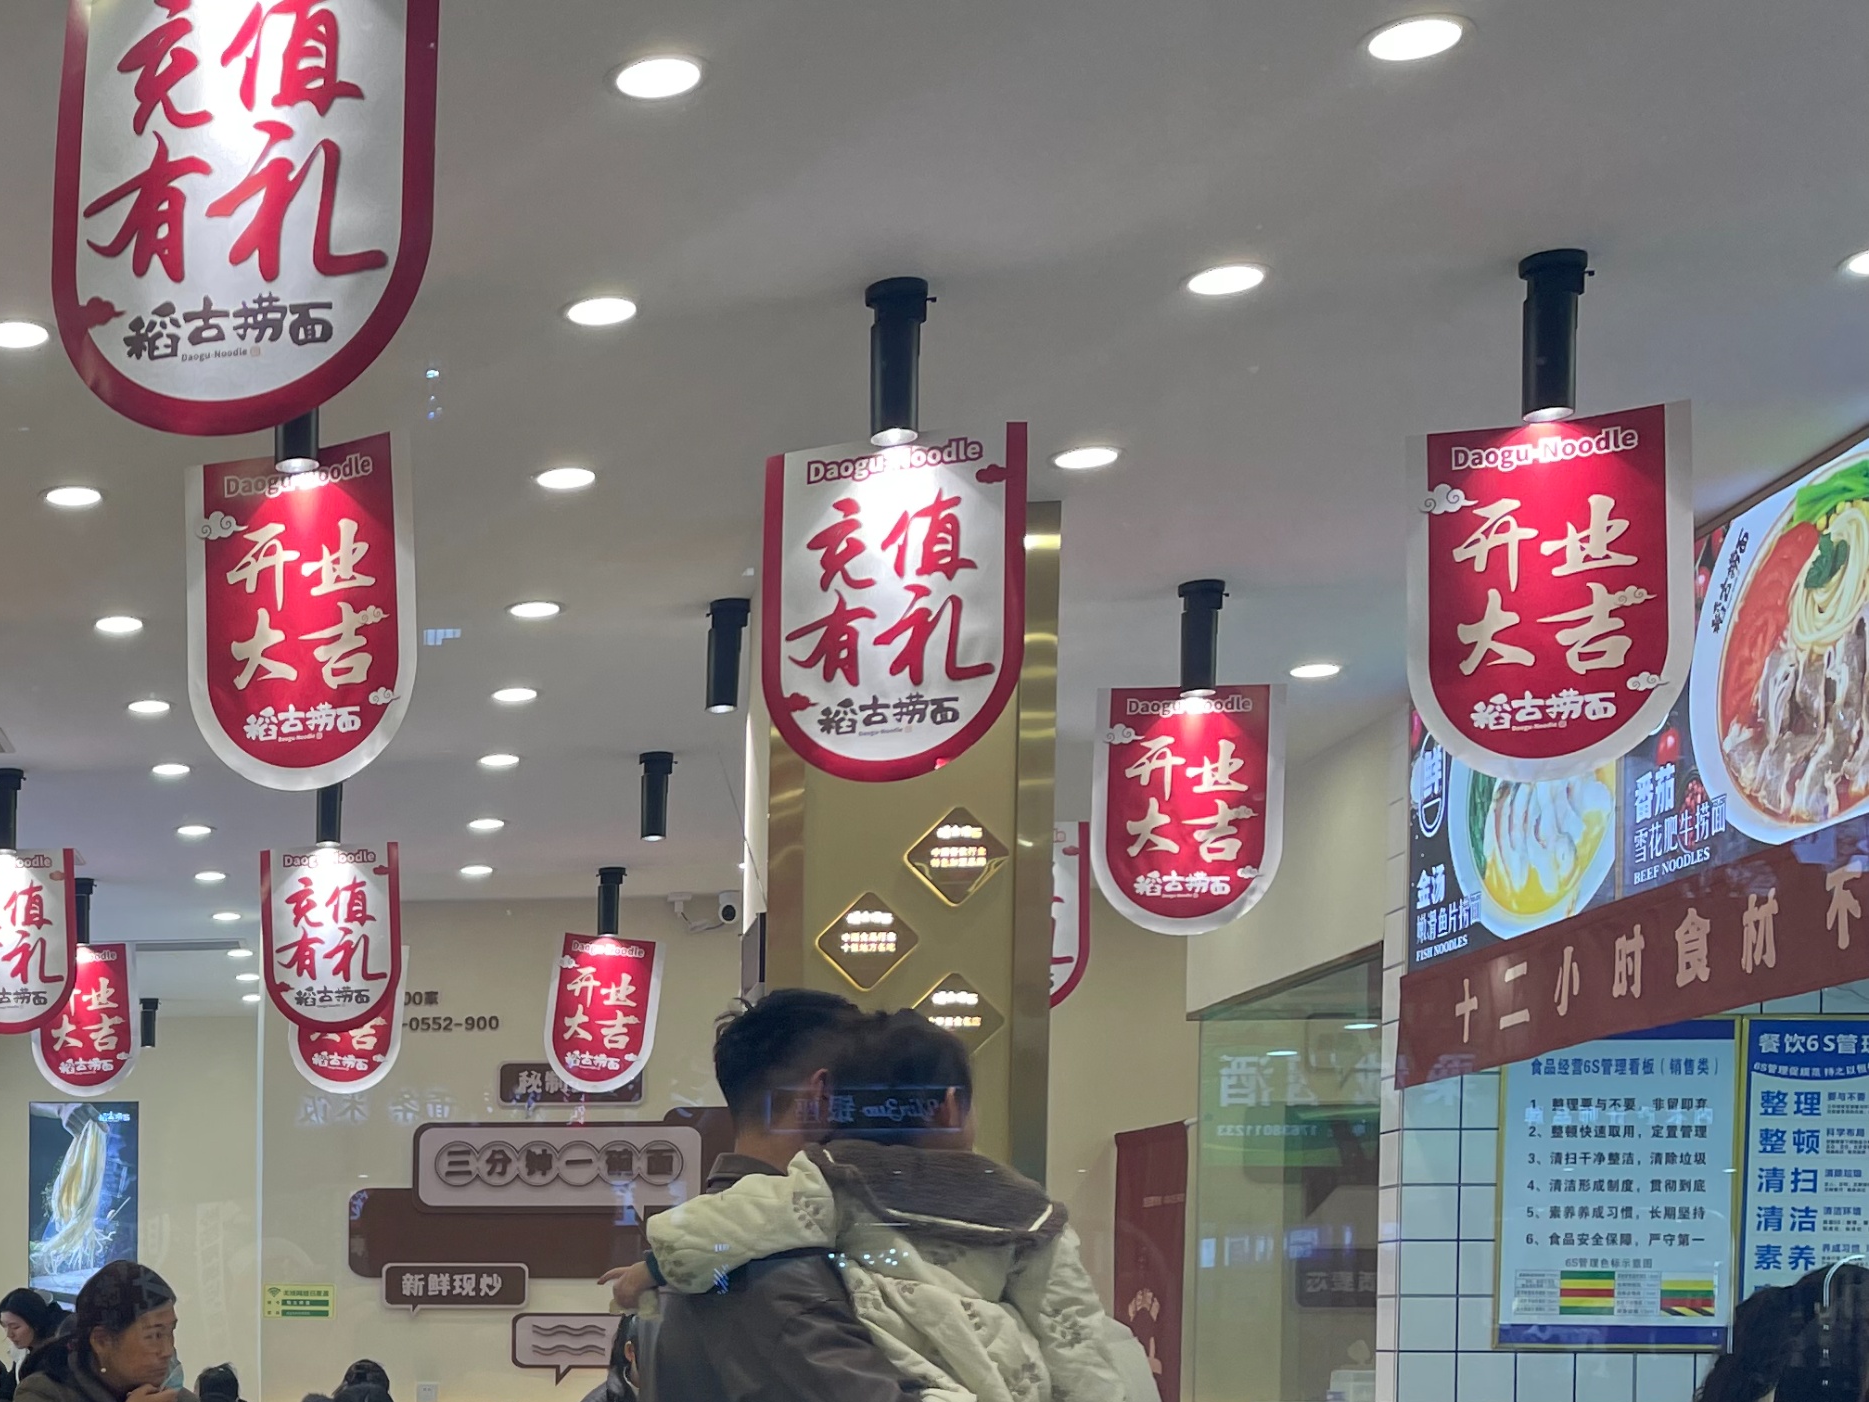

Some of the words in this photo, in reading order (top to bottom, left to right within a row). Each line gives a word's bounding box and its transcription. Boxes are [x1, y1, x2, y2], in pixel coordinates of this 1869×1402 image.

[117, 0, 364, 135] 充值
[83, 121, 388, 283] 有礼
[123, 292, 333, 361] 稻古捞面
[807, 488, 978, 591] 充值
[1452, 494, 1638, 592] 开业
[226, 518, 376, 611] 开业
[231, 601, 373, 690] 大吉
[785, 584, 995, 687] 有礼
[1456, 582, 1633, 675] 大吉
[243, 701, 362, 741] 稻古捞面
[817, 692, 960, 735] 稻古捞面
[1470, 688, 1617, 730] 稻古捞面
[1125, 735, 1249, 801] 开业
[1634, 762, 1676, 824] 番茄
[1126, 797, 1244, 863] 大吉
[1634, 793, 1728, 864] 雪花肥牛捞面
[1133, 870, 1231, 897] 稻古捞面
[1416, 863, 1446, 910] 金汤
[1633, 864, 1660, 885] BEEF
[1661, 846, 1710, 876] NOODLES
[285, 875, 376, 928] 充值
[276, 926, 387, 982] 有礼
[1415, 942, 1433, 962] FISH
[1433, 934, 1468, 957] NOODLES
[1455, 860, 1862, 1044] 十二小时食材不
[294, 985, 370, 1007] 稻古捞面
[567, 966, 637, 1008] 开业
[51, 1013, 121, 1052] 大吉
[563, 1004, 632, 1050] 大吉
[59, 1058, 114, 1075] 稻古捞面
[312, 1051, 368, 1071] 稻古捞面
[1759, 1090, 1822, 1117] 整理
[1758, 1127, 1820, 1155] 整顿
[1757, 1166, 1818, 1194] 清扫
[1756, 1206, 1818, 1233] 清洁
[1754, 1243, 1816, 1271] 素养
[401, 1272, 502, 1298] 新鲜现炒
